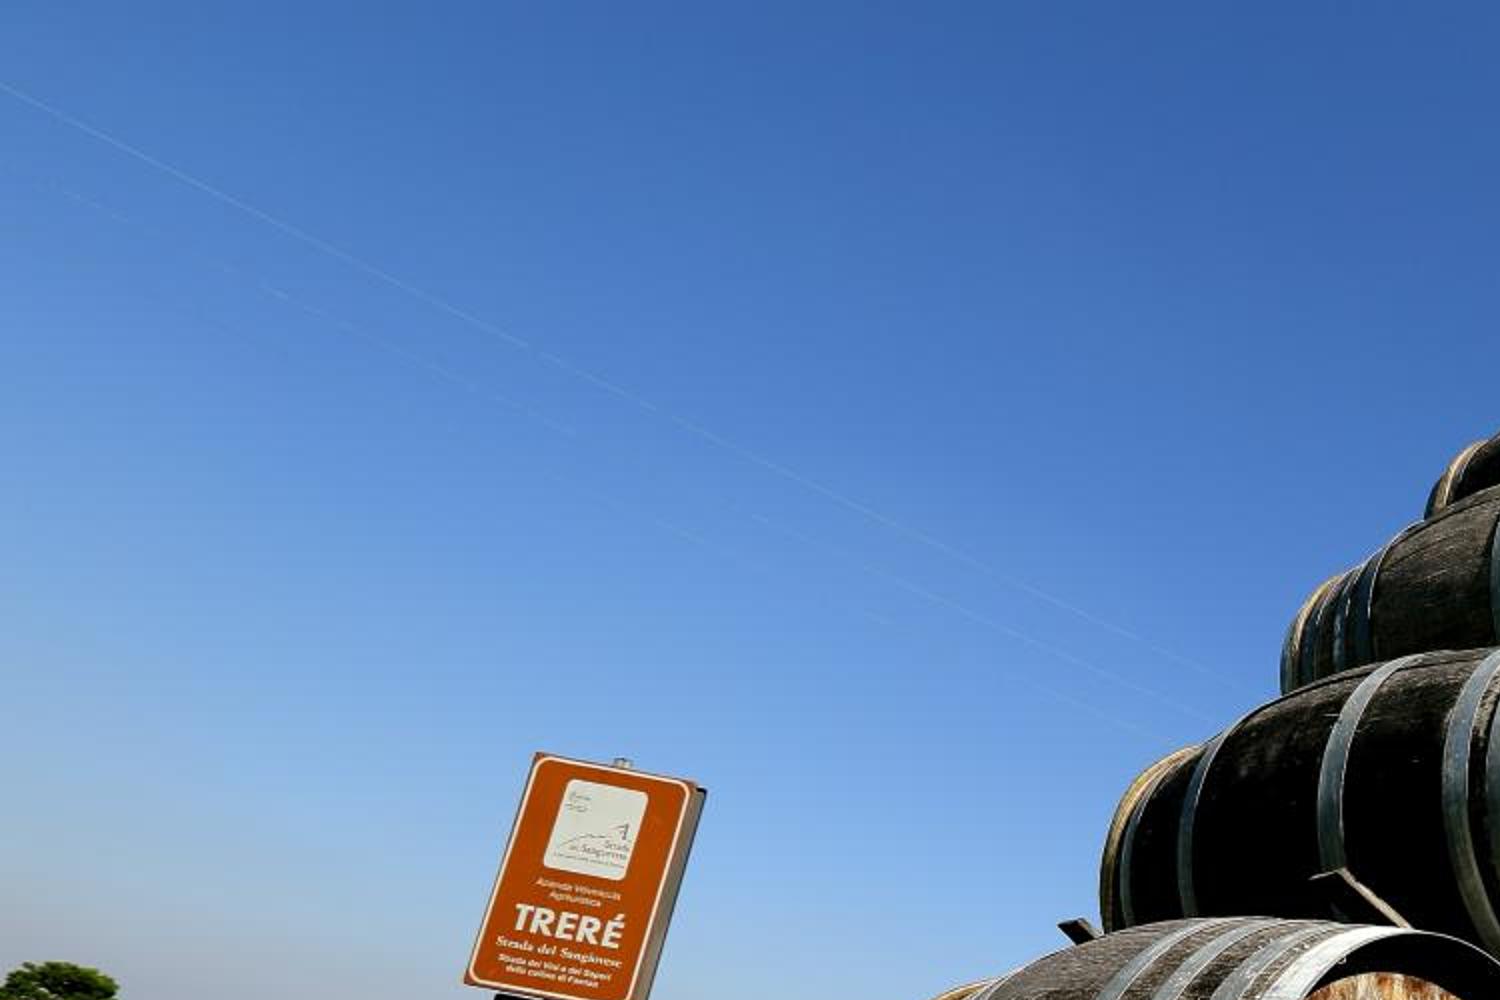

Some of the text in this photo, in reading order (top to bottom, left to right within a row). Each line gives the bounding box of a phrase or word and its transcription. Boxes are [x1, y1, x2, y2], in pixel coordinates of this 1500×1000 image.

[514, 903, 625, 949] TRERÉ
[496, 935, 623, 969] Strada del Sangiovese
[498, 953, 526, 965] Strada
